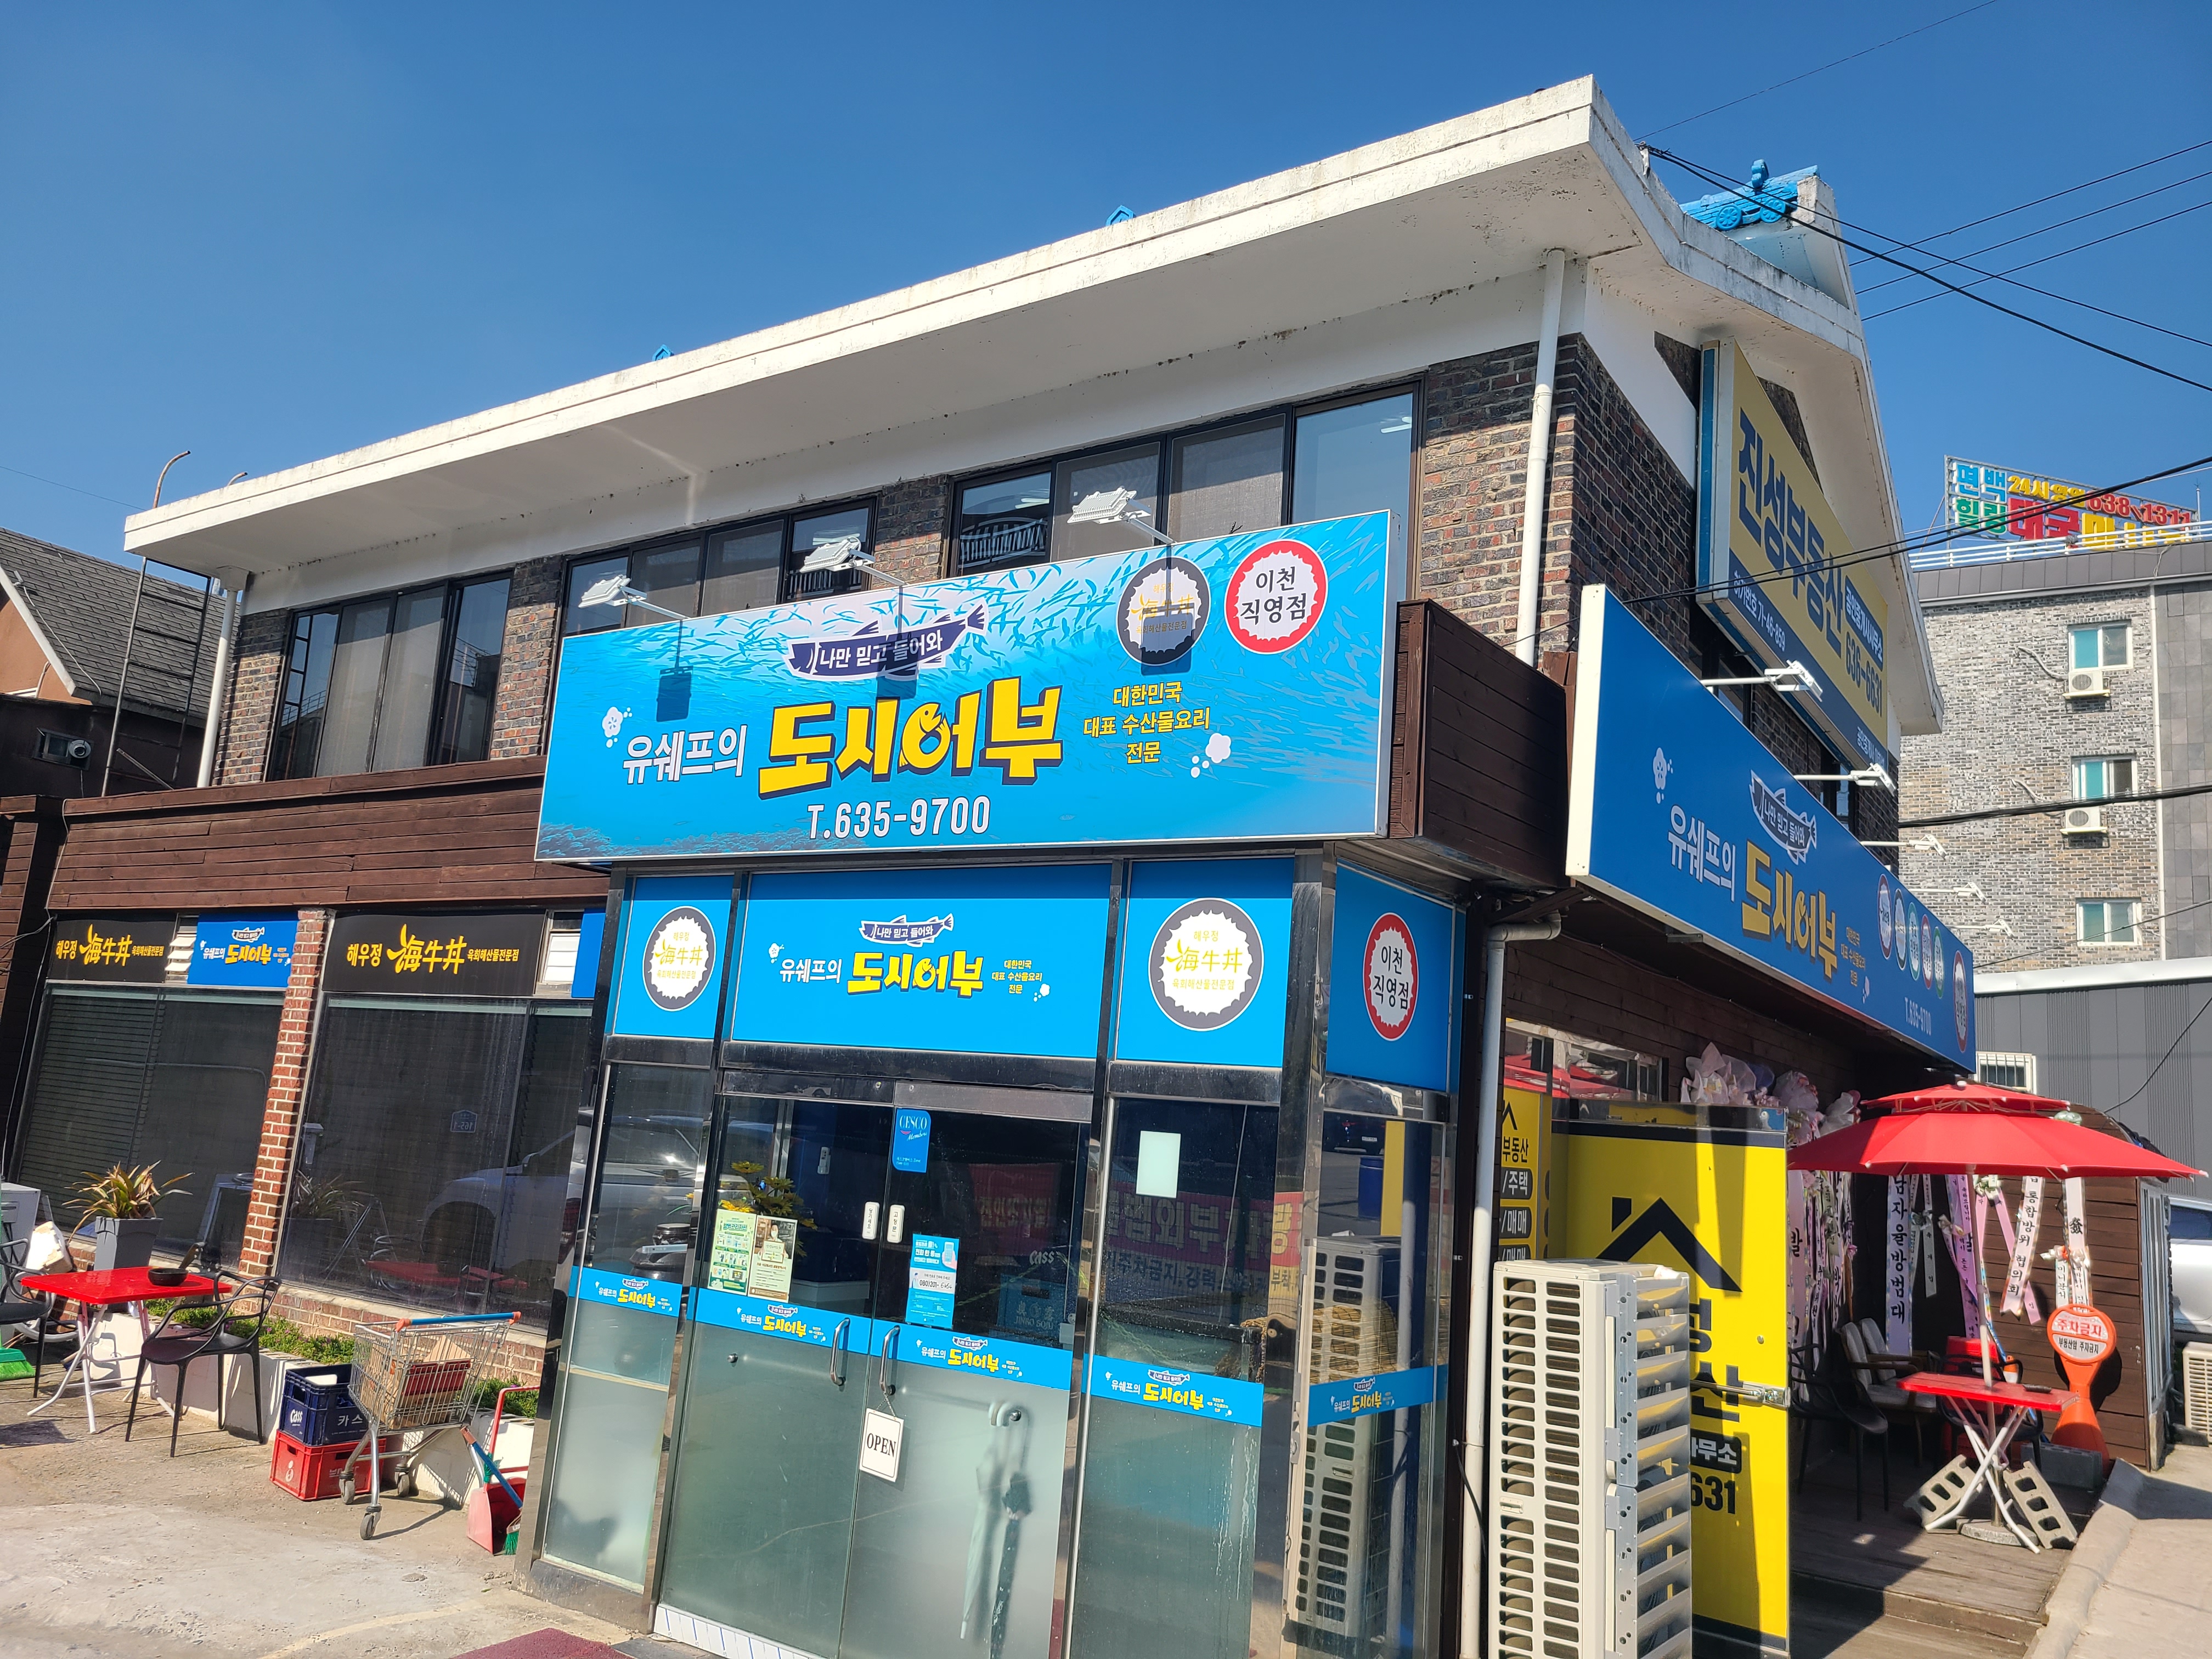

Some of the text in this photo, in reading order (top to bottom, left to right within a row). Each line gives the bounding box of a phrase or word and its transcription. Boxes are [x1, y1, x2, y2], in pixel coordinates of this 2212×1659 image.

[1953, 461, 2007, 503] 편백
[1737, 407, 1842, 658] 진성부동산
[1153, 583, 1174, 593] 해우정
[1256, 566, 1296, 594] 이천
[1240, 593, 1307, 625] 직영점
[1734, 570, 1785, 652] 허가번호 가-46-859
[1136, 620, 1187, 634] 육회해산물전문점
[820, 633, 944, 669] 나만 믿고 들어와
[1846, 631, 1882, 718] 636-6631
[1113, 681, 1183, 707] 대한민국
[1084, 707, 1211, 738] 대표 수산물요리
[623, 676, 1063, 800] 유쉐프의 도시어부
[1126, 741, 1161, 764] 전문
[807, 795, 991, 840] T.635-9700
[1764, 799, 1805, 847] 나만 믿고 들어와
[1667, 804, 1838, 982] 유쉐프의 도시어부
[673, 932, 690, 941] 해우정
[876, 926, 934, 938] 나만 믿고 들어와
[1193, 930, 1219, 942] 해우정
[55, 940, 78, 960] 해우정
[225, 944, 273, 964] 도시어부
[347, 943, 382, 967] 해우정
[467, 949, 520, 962] 육회해산물전문점
[1381, 945, 1403, 975] 이천
[780, 950, 985, 998] 유쉐프의 도시어부
[991, 971, 1043, 983] 대표 수산물요리
[1003, 960, 1032, 970] 대한민국
[1008, 984, 1023, 995] 전문
[1172, 978, 1234, 990] 육회해산물전문점
[1373, 974, 1410, 1011] 직영점
[900, 1115, 927, 1130] CESCO
[1502, 1136, 1528, 1164] 부동산
[1502, 1170, 1528, 1195] /주택
[2019, 1191, 2039, 1246] 통합방위
[2007, 1255, 2026, 1296] 협의회
[618, 1288, 656, 1308] 도시어부
[763, 1315, 806, 1338] 도시어부
[2057, 1318, 2102, 1337] 주차금지
[921, 1346, 946, 1359] 유쉐프의
[947, 1348, 999, 1373] 도시어부
[2080, 1341, 2098, 1354] 주차금지
[1111, 1379, 1141, 1395] 유쉐프의
[1143, 1383, 1204, 1410] 도시어부
[1351, 1391, 1382, 1413] 도시어부
[290, 1409, 363, 1426] Cass 카스
[866, 1432, 896, 1457] OPEN
